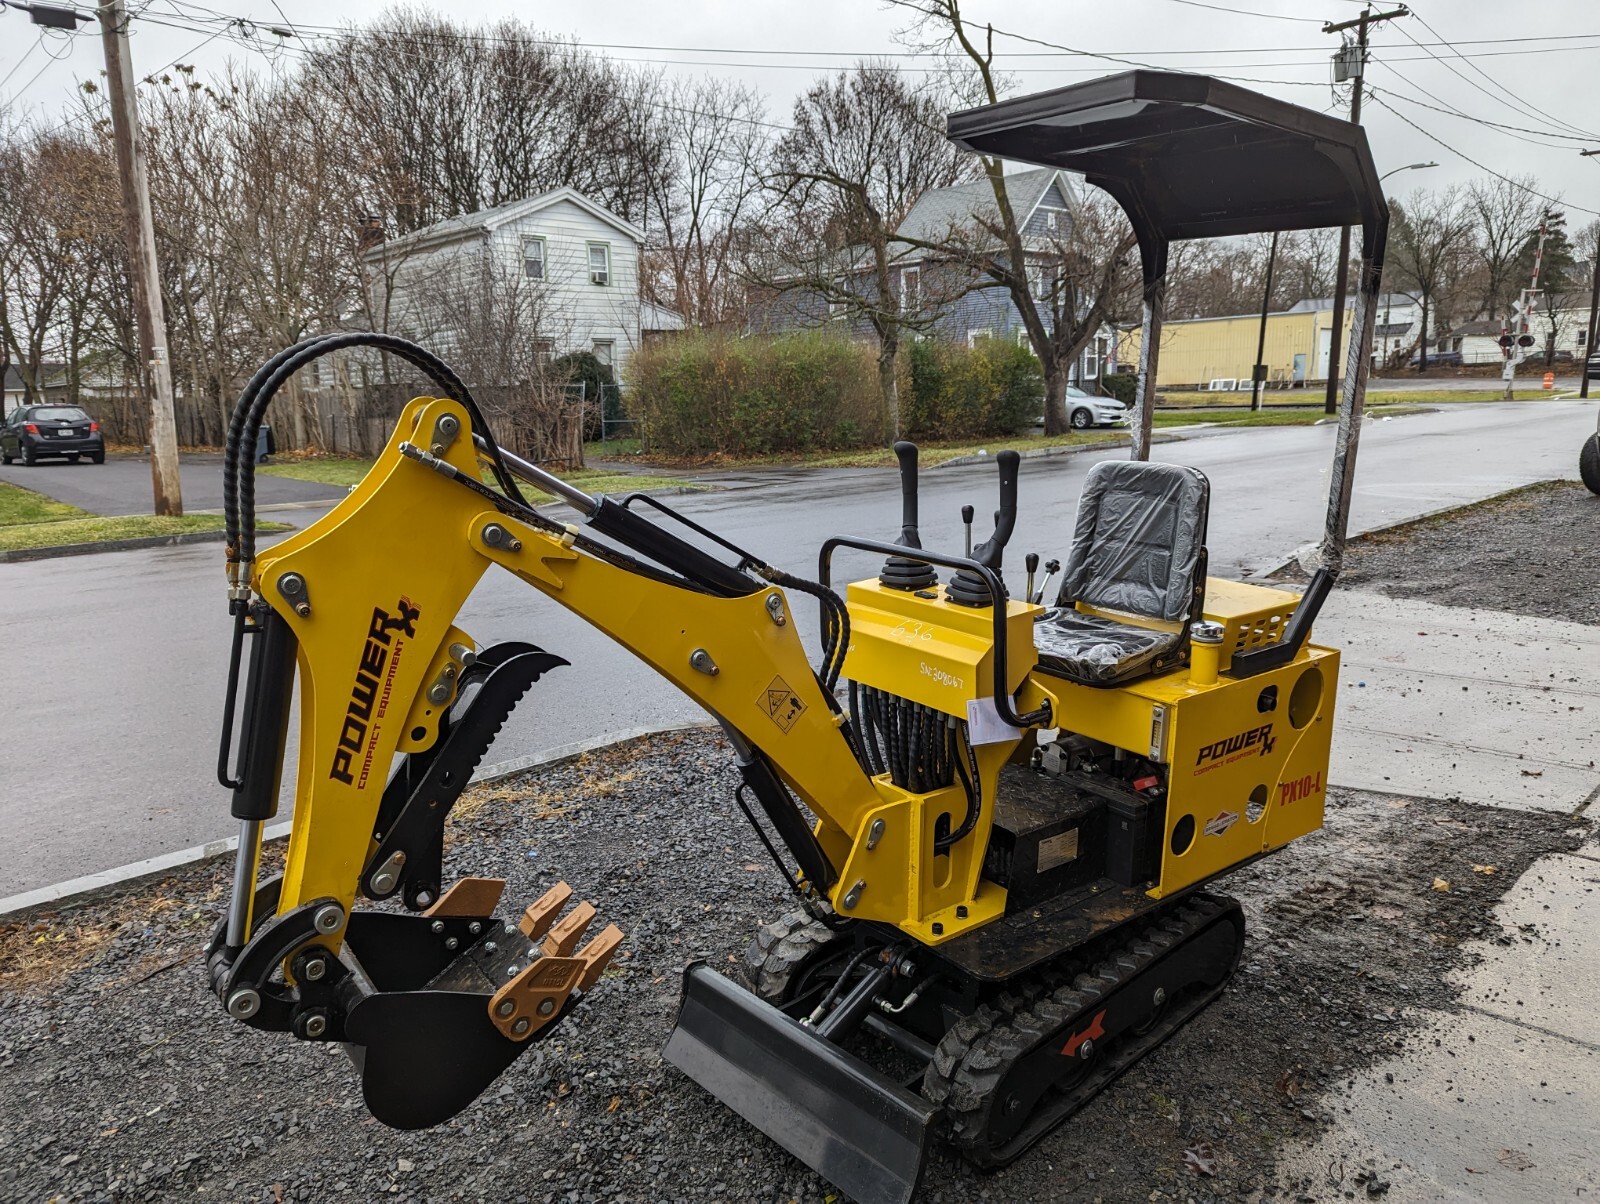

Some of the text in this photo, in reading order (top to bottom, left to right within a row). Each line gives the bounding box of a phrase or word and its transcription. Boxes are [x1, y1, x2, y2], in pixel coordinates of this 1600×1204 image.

[890, 620, 934, 641] 636
[357, 638, 404, 790] COMPACT EQUIPMENT
[1194, 747, 1261, 776] COMPACT EQUIPMENT
[1281, 771, 1321, 806] PX10-L
